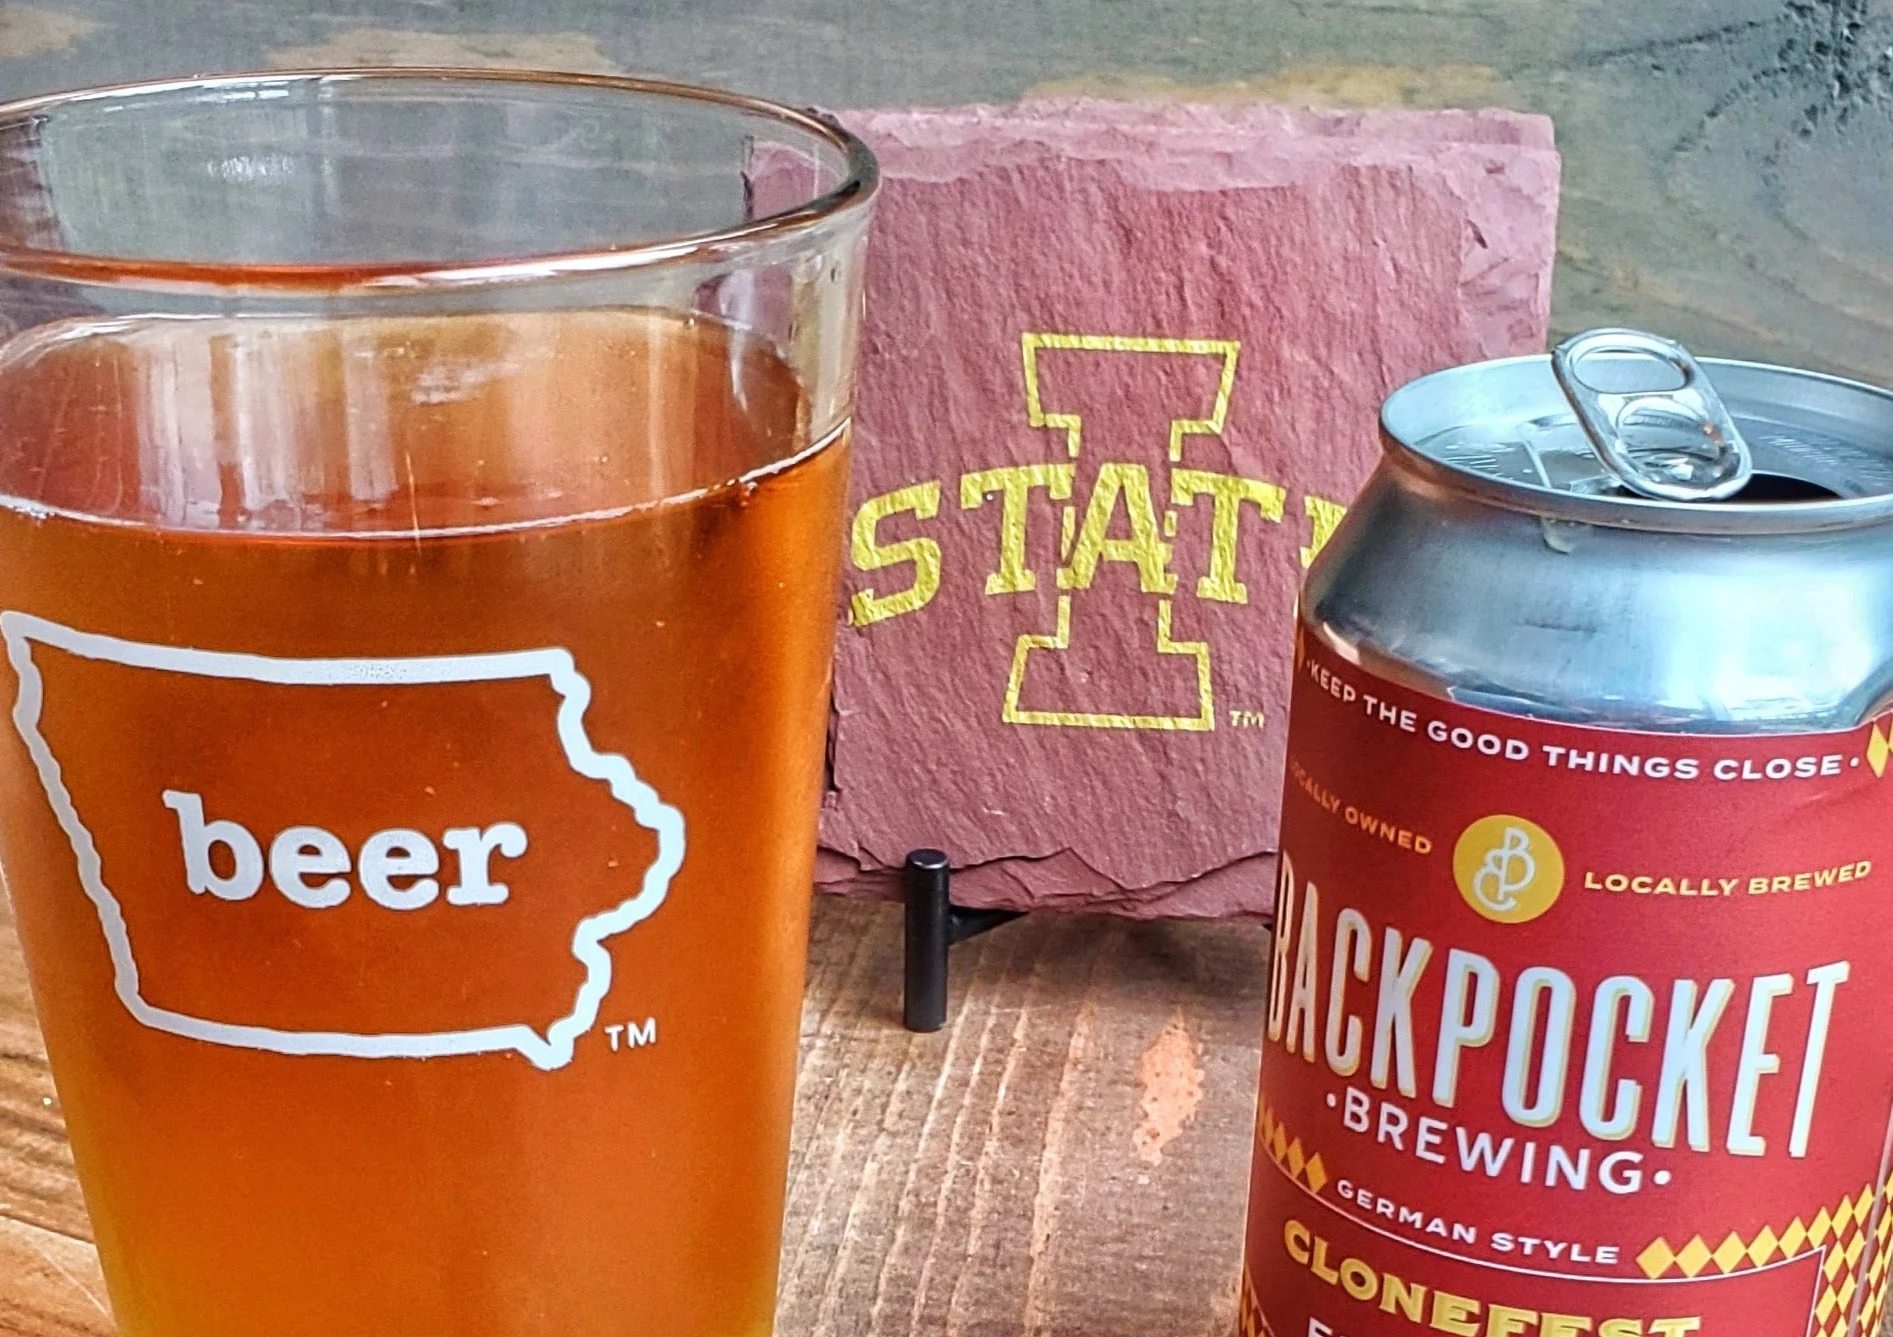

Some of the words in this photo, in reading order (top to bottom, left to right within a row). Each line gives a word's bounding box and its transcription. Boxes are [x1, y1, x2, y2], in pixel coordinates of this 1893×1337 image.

[1229, 711, 1265, 730] TM
[1310, 659, 1356, 702] KEEP
[1363, 695, 1418, 733] THE
[1427, 721, 1530, 761] GOOD
[1543, 745, 1699, 780] THINGS
[1713, 754, 1843, 781] CLOSE
[162, 789, 528, 910] beer
[1344, 806, 1433, 855] OWNED
[1584, 871, 1738, 897] LOCALLY
[1748, 860, 1872, 895] BREWED
[605, 1017, 658, 1052] TM
[1268, 850, 1850, 1158] BACKPOCKET
[1343, 1086, 1643, 1192] BREWING
[1337, 1179, 1477, 1244] GERMAN
[1491, 1236, 1620, 1264] STYLE
